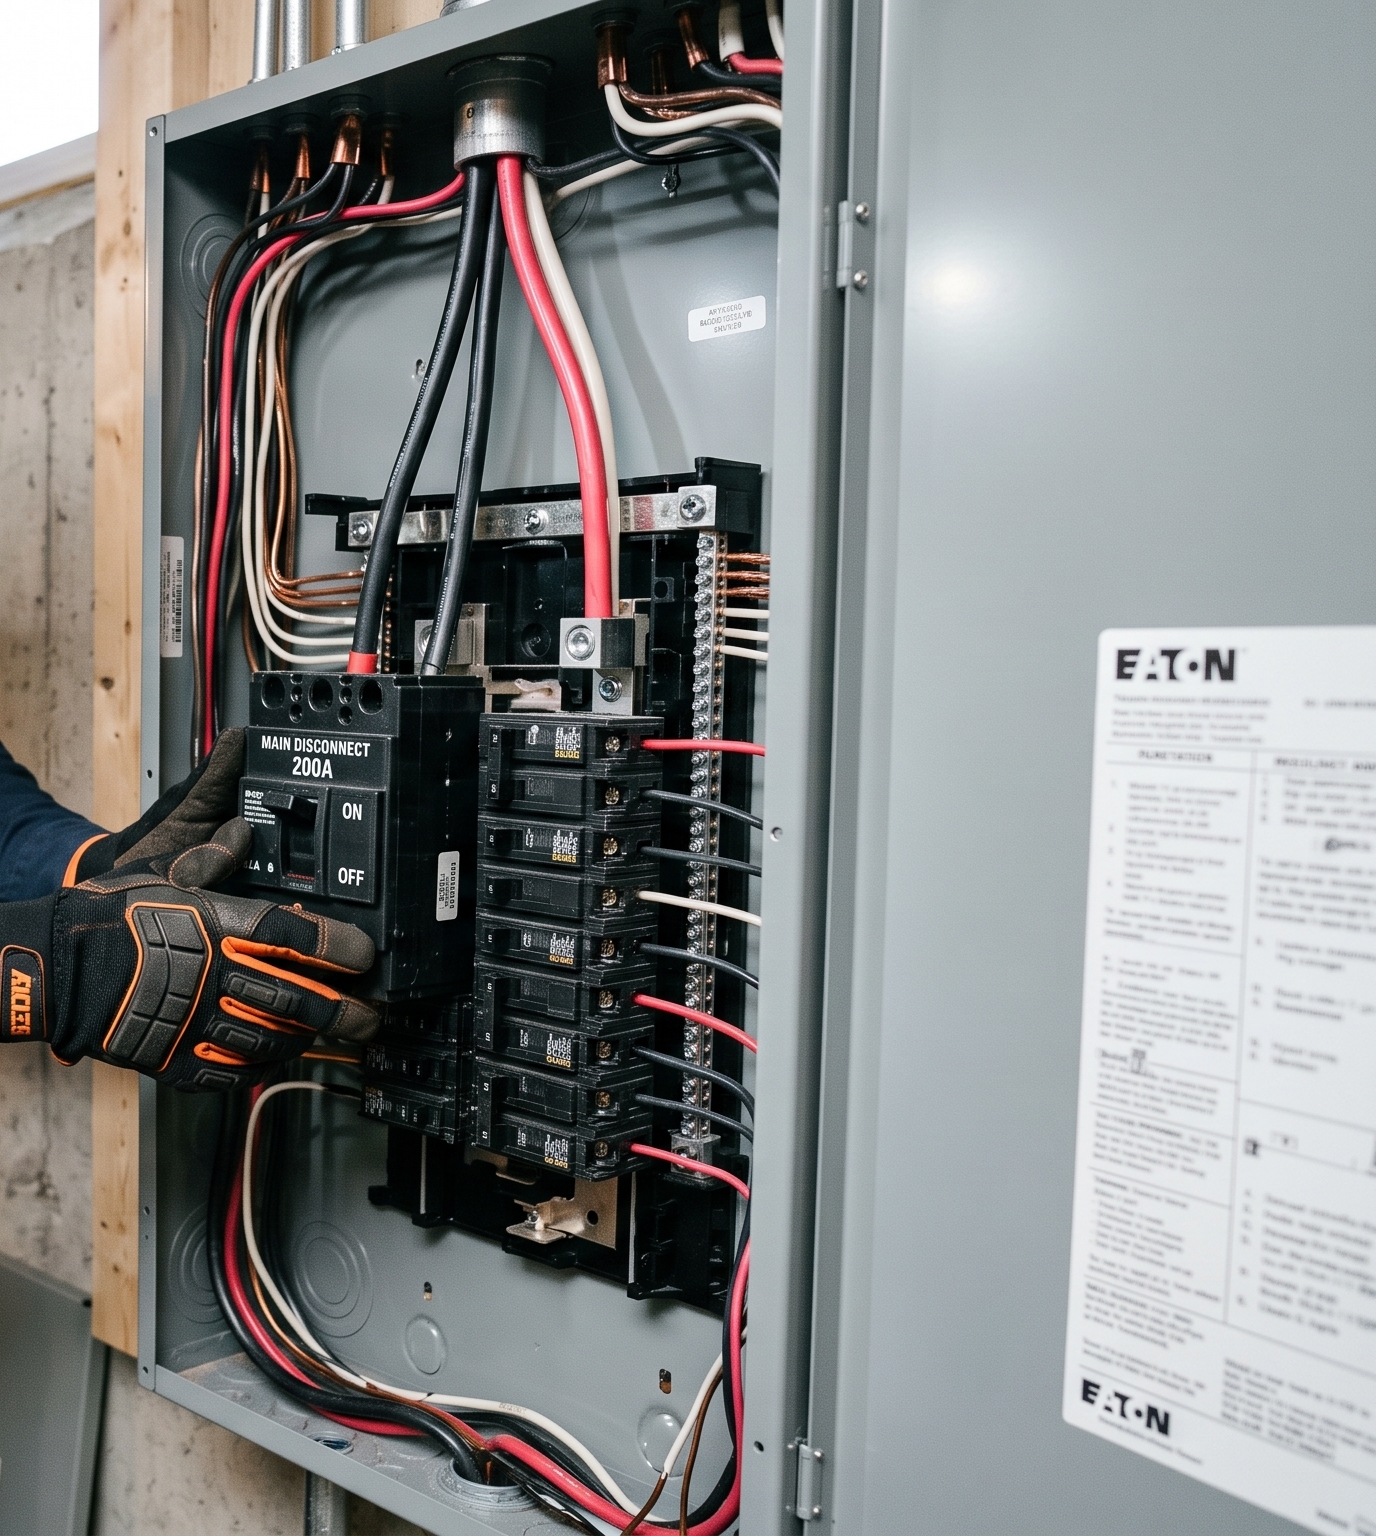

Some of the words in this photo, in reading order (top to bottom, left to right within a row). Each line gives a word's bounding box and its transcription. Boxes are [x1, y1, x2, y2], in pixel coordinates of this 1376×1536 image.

[261, 735, 291, 751] MAIN
[294, 737, 371, 757] DISCONNECT
[292, 756, 333, 779] 200A
[342, 802, 363, 821] ON
[338, 867, 365, 886] OFF
